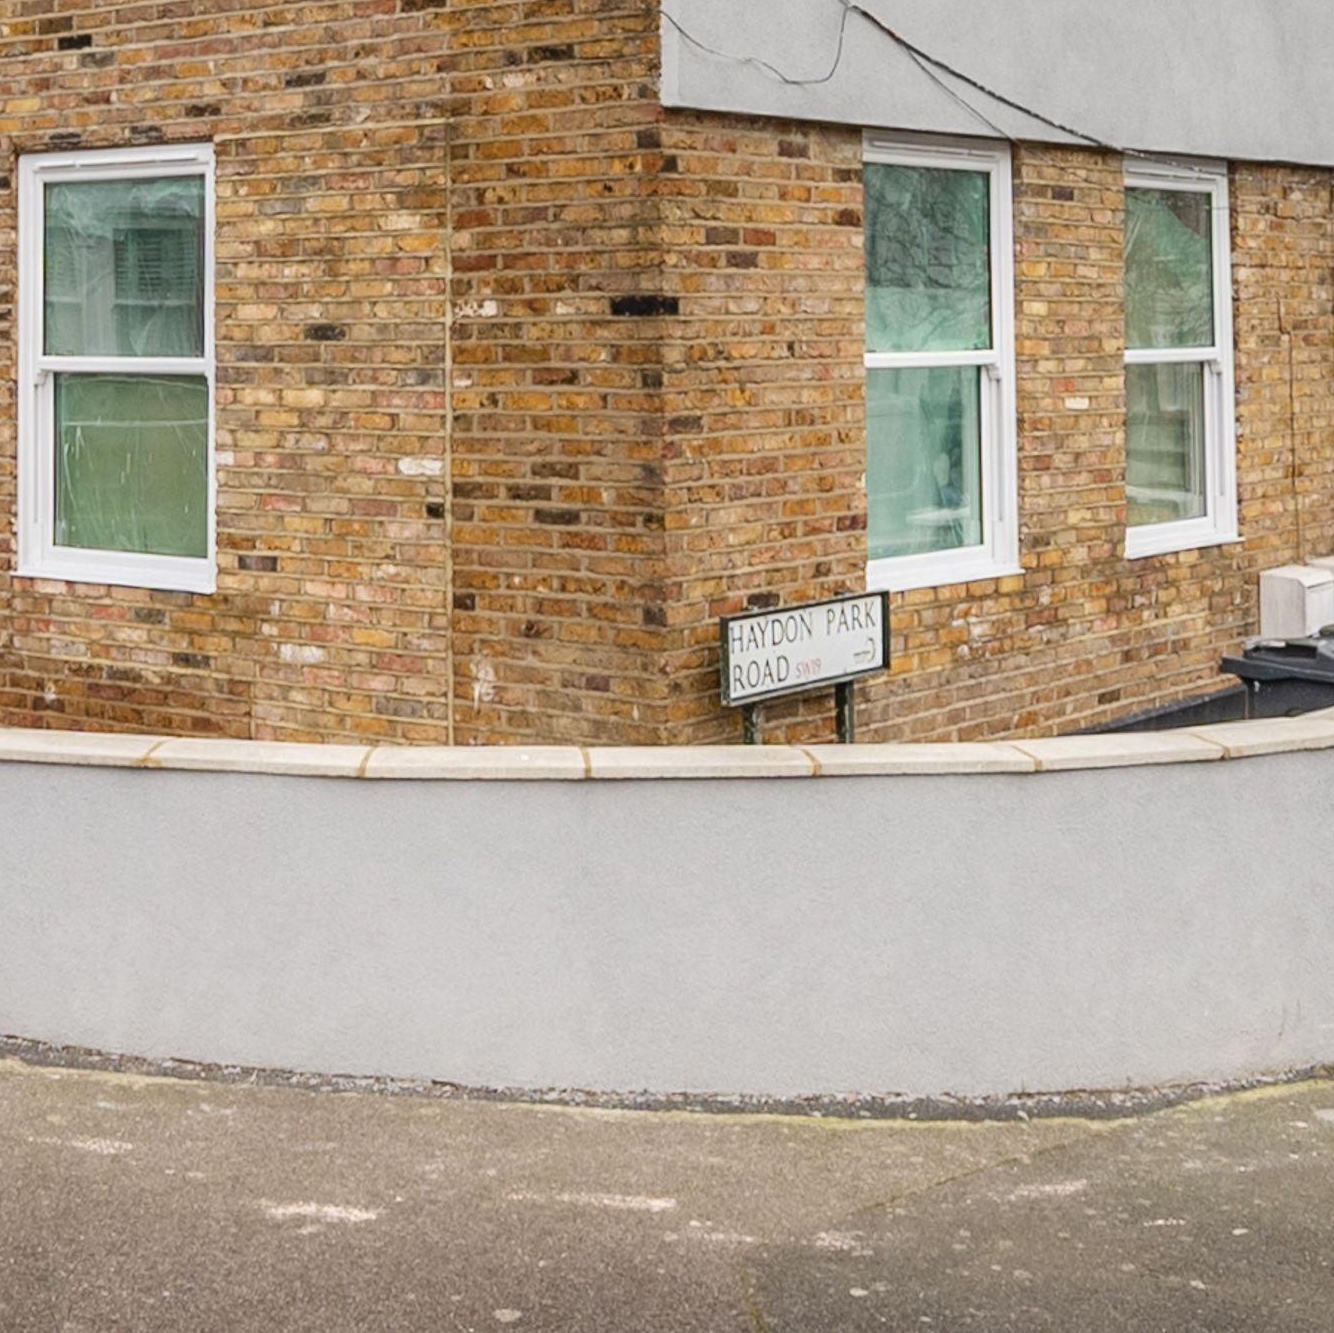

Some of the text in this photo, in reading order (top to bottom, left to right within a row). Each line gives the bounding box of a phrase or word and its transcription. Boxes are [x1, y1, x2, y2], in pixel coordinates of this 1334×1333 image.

[730, 601, 876, 654] HAYDON PARK
[733, 655, 822, 693] ROAD SW19
